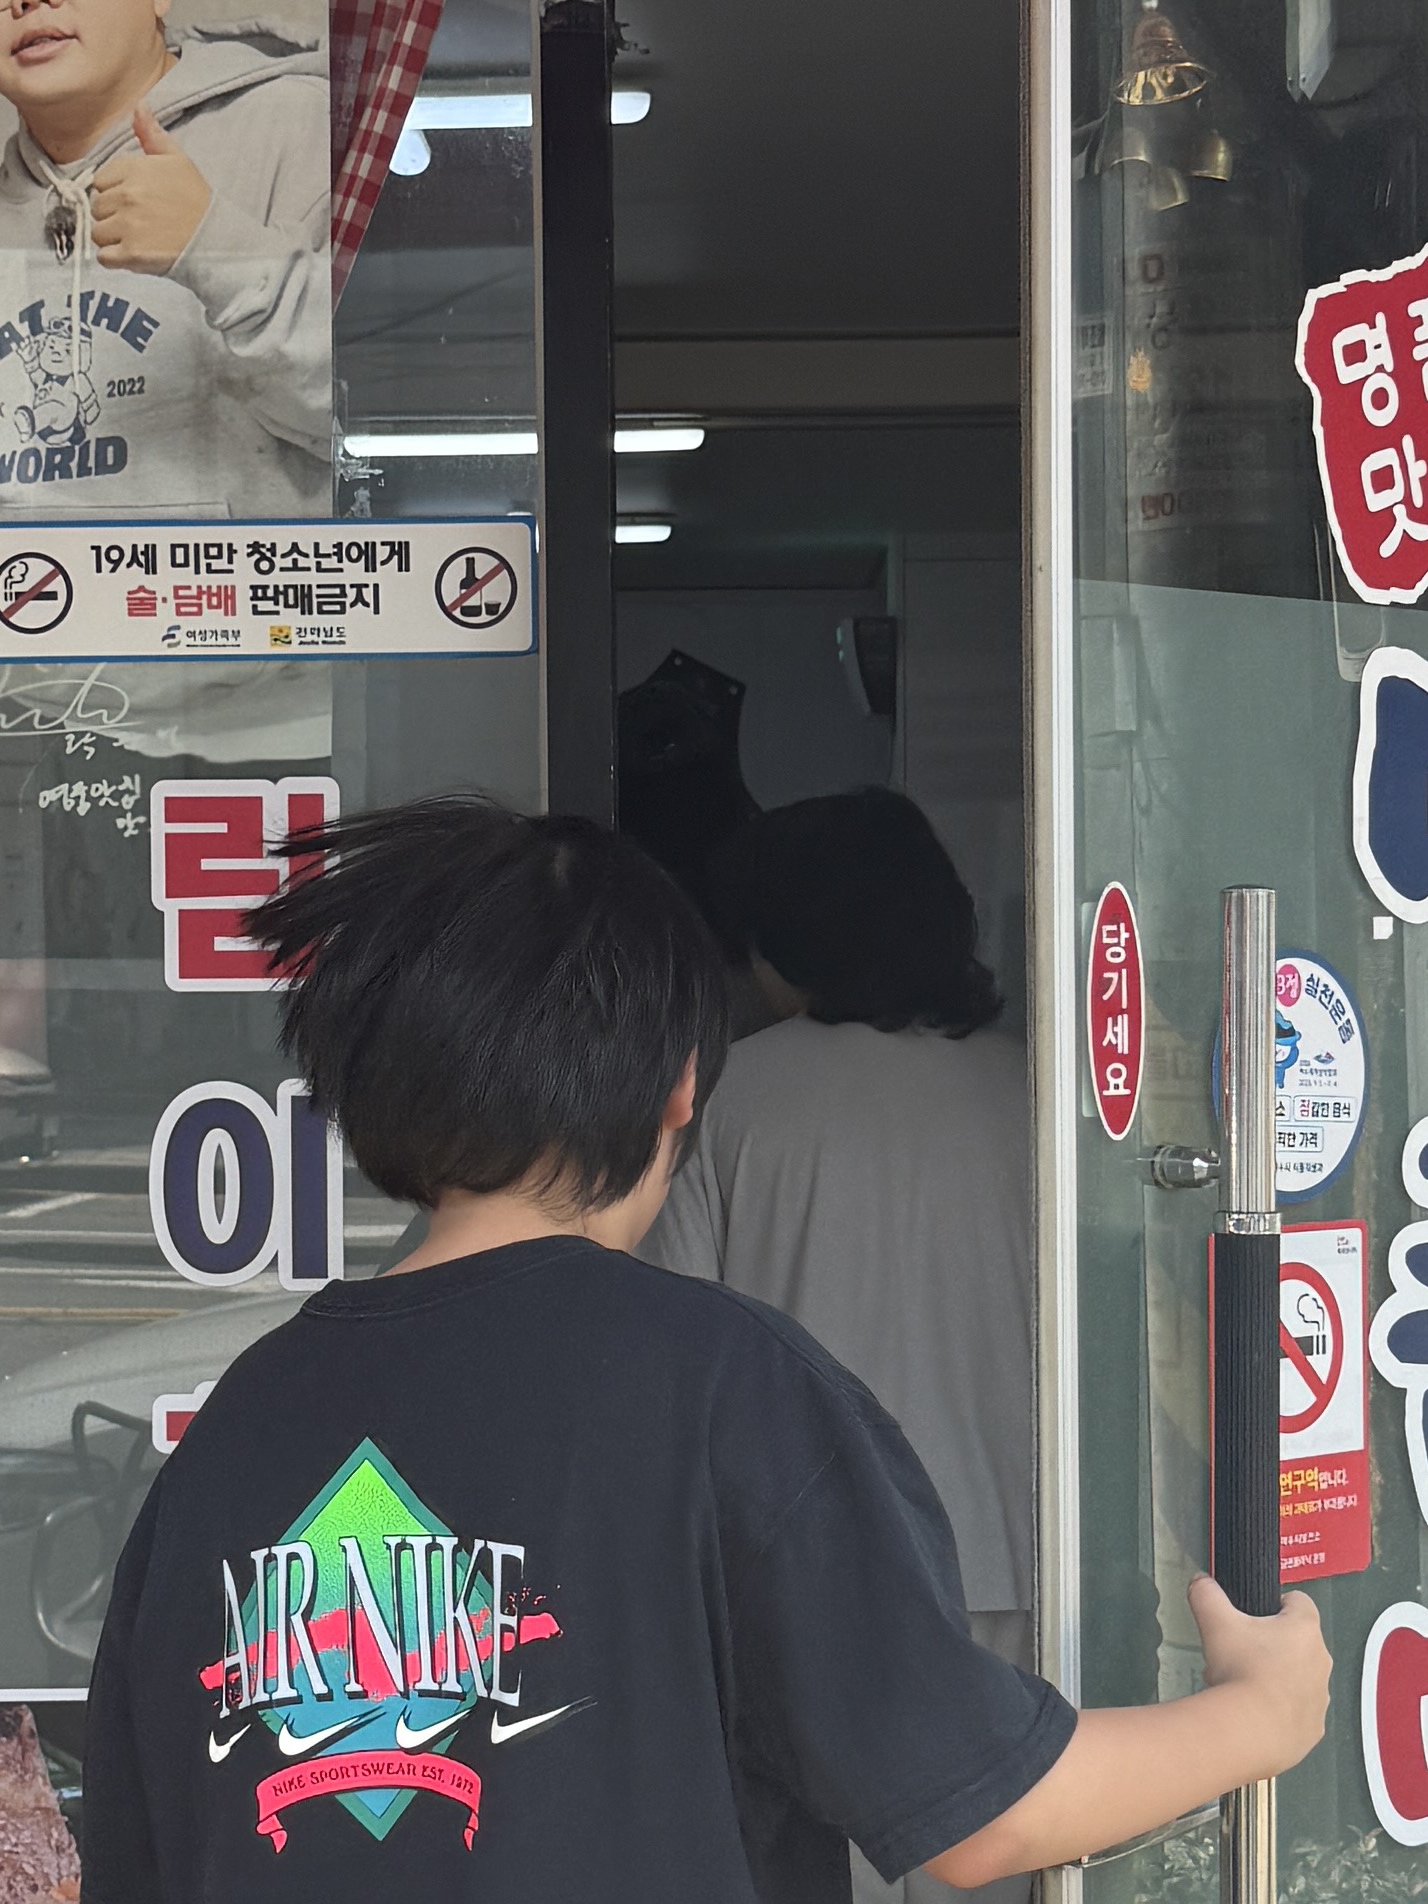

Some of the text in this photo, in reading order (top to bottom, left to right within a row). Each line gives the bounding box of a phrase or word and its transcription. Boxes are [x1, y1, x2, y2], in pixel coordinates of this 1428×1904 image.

[66, 289, 160, 354] THE
[106, 376, 146, 398] 2022
[90, 539, 411, 576] 19세 미만 청소년에게
[126, 582, 380, 618] 술·담배 판매금지
[1098, 920, 1133, 1097] 당기세요
[219, 1534, 526, 1719] AIR NIKE
[272, 1774, 306, 1797] NIKE
[310, 1762, 417, 1785] SPORTSWEAR
